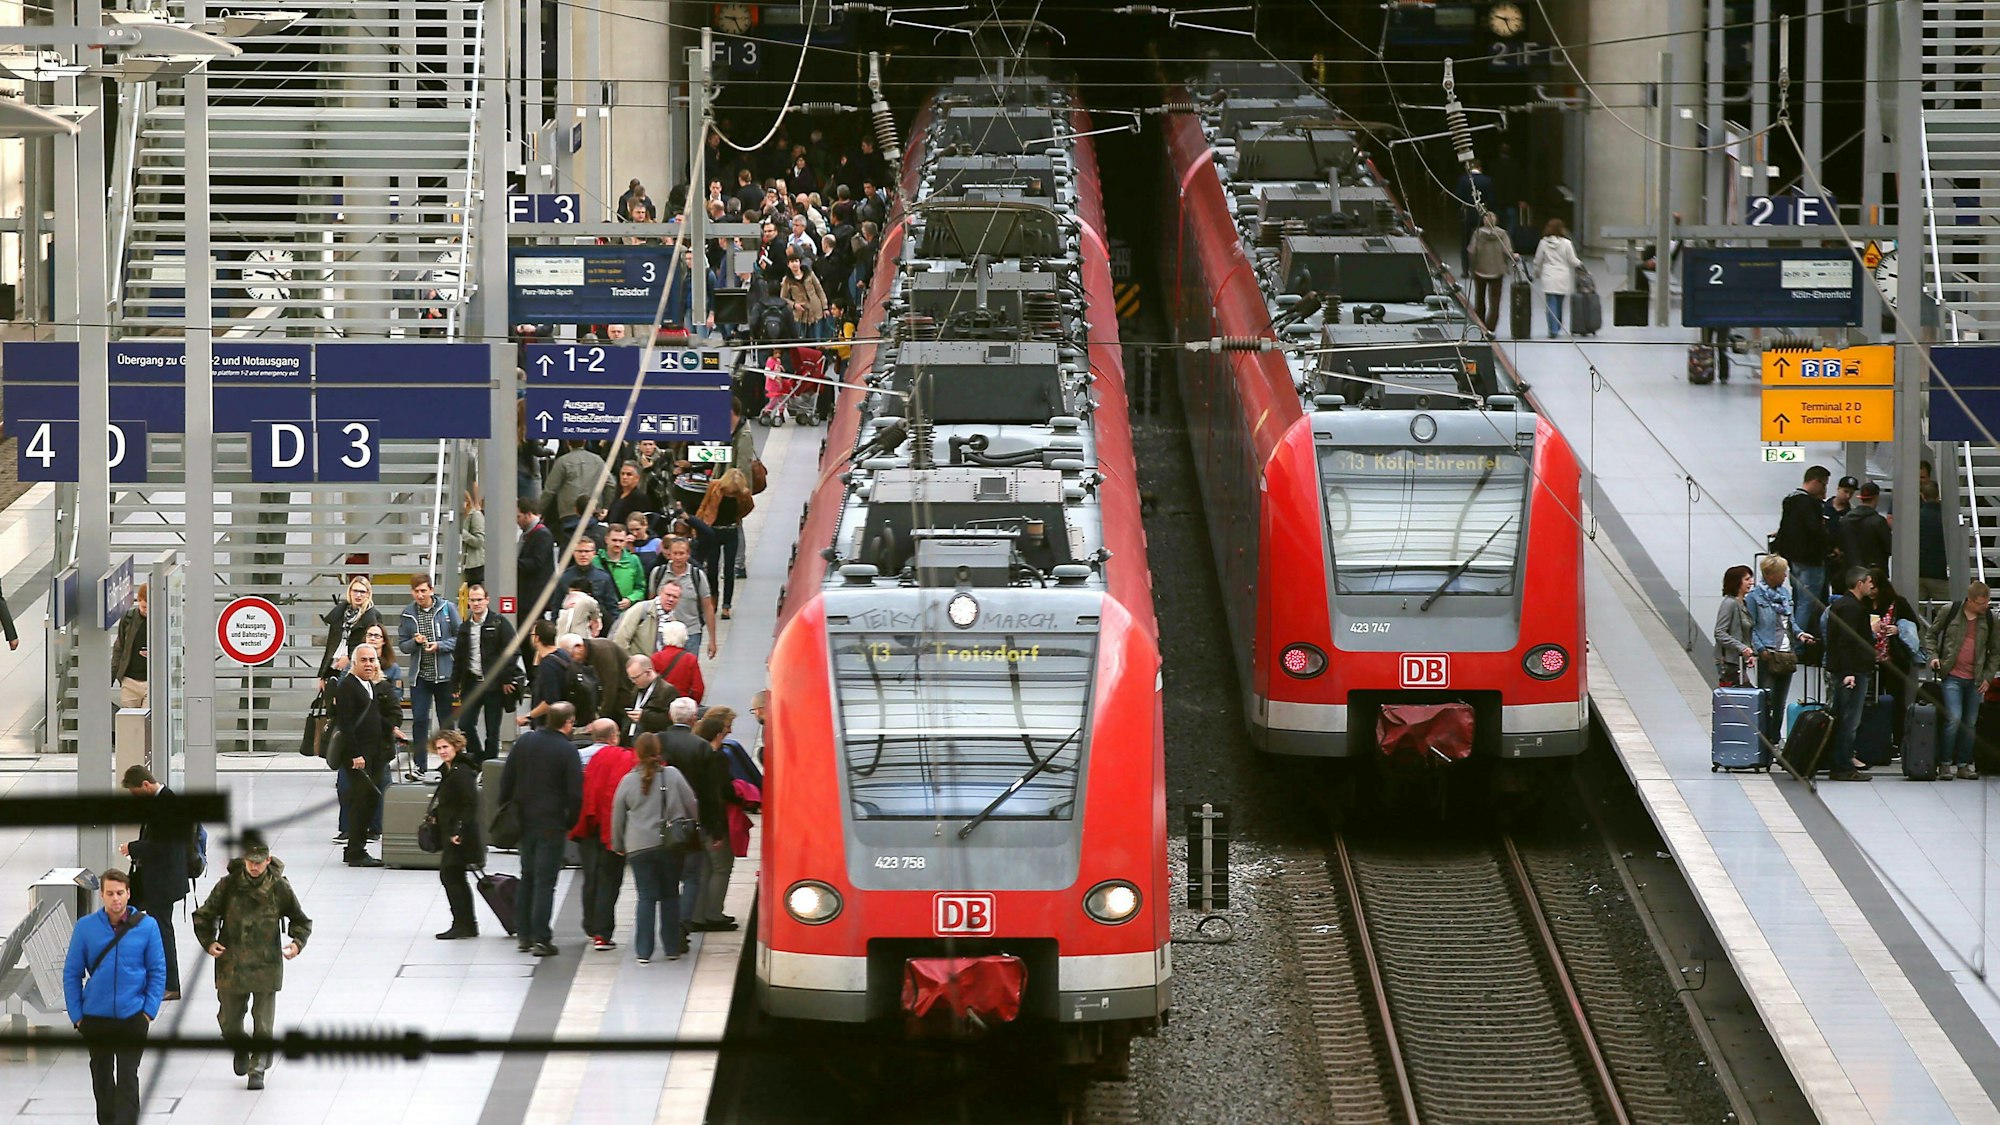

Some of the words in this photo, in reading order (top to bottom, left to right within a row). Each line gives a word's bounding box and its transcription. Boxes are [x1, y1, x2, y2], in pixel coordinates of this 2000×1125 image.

[712, 42, 725, 61] F
[742, 42, 757, 64] 3
[1492, 42, 1507, 65] 2
[553, 195, 575, 224] 3
[1752, 198, 1774, 226] 2
[641, 262, 656, 283] 3
[1709, 264, 1724, 285] 2
[611, 287, 649, 297] Troisdorf
[117, 353, 164, 367] Übergang
[165, 356, 178, 365] zu
[222, 356, 241, 365] und
[242, 355, 300, 367] Notausgang
[563, 347, 606, 372] 1-2
[683, 356, 697, 364] Bus
[563, 400, 606, 412] Ausgang
[1801, 402, 1842, 411] Terminal
[1845, 402, 1852, 411] 2
[1854, 402, 1862, 411] D
[1801, 415, 1842, 424] Terminal
[1846, 415, 1851, 424] 1
[1854, 415, 1862, 424] C
[25, 423, 56, 468] 4
[271, 423, 305, 468] D
[340, 423, 371, 469] 3
[242, 631, 271, 639] Bahnsteig-
[1349, 623, 1369, 633] 423
[1372, 623, 1391, 633] 747
[933, 642, 1040, 663] Troisdorf
[1406, 659, 1443, 682] DB
[874, 857, 898, 869] 423
[901, 857, 926, 869] 758
[941, 900, 988, 929] DB
